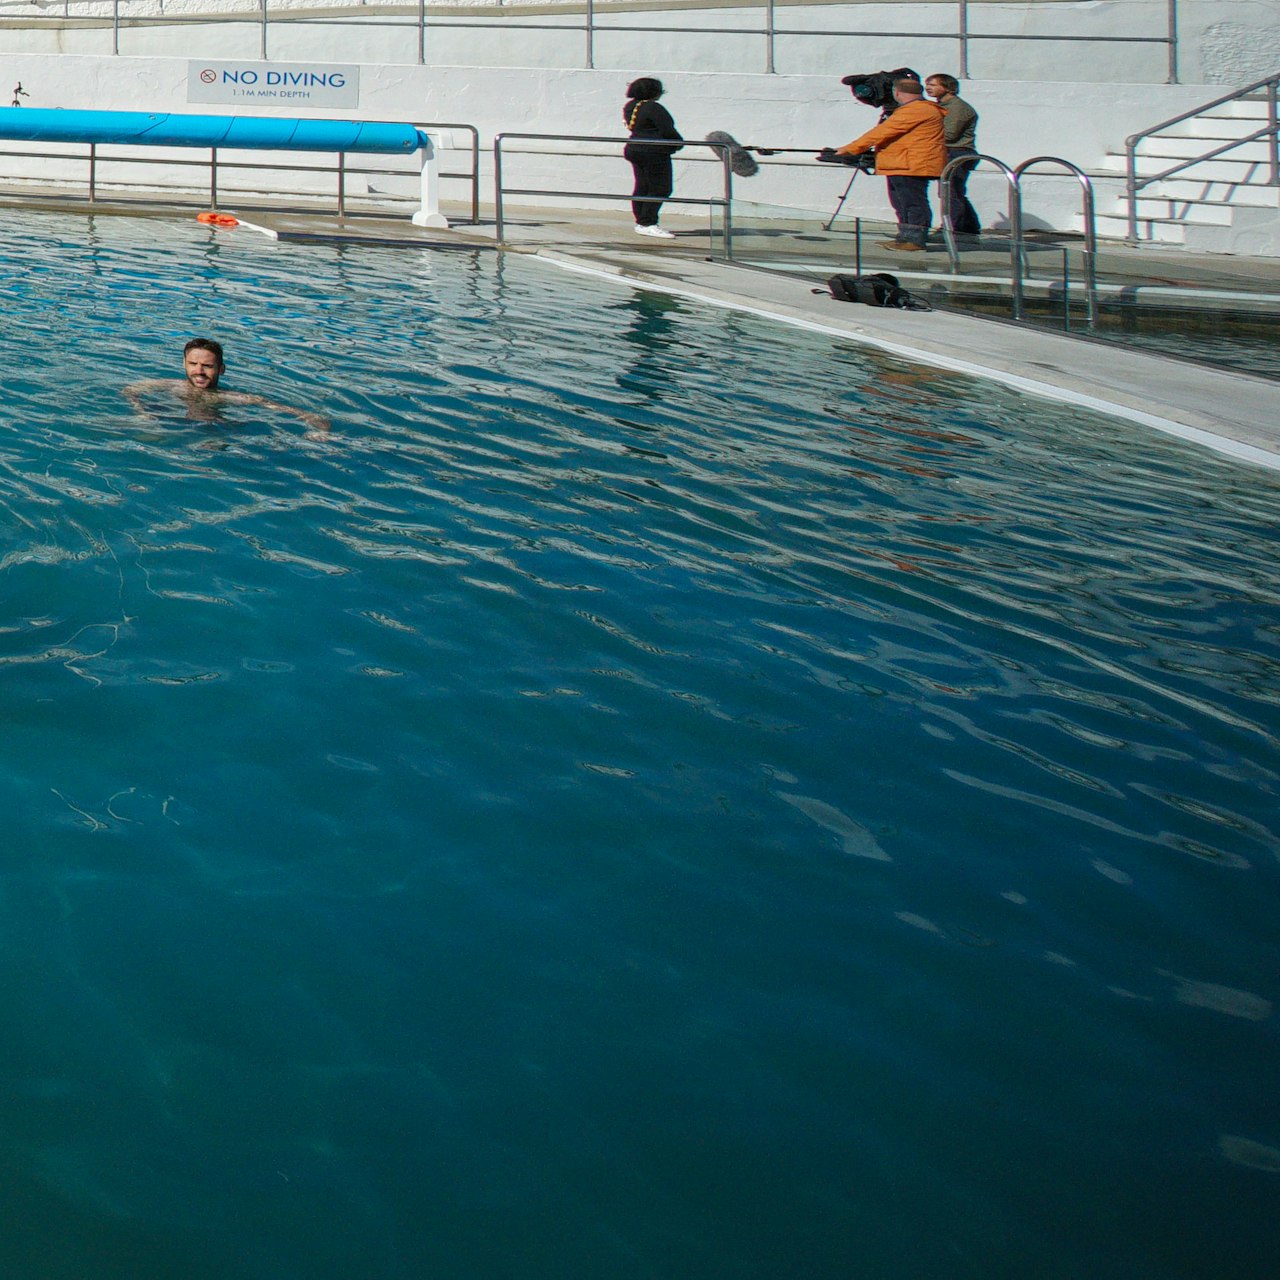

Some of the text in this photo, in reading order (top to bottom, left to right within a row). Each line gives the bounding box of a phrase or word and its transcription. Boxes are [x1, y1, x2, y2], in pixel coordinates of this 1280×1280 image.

[223, 70, 346, 88] NO DIVING
[232, 88, 311, 99] 1.1M MIN DEPTH
